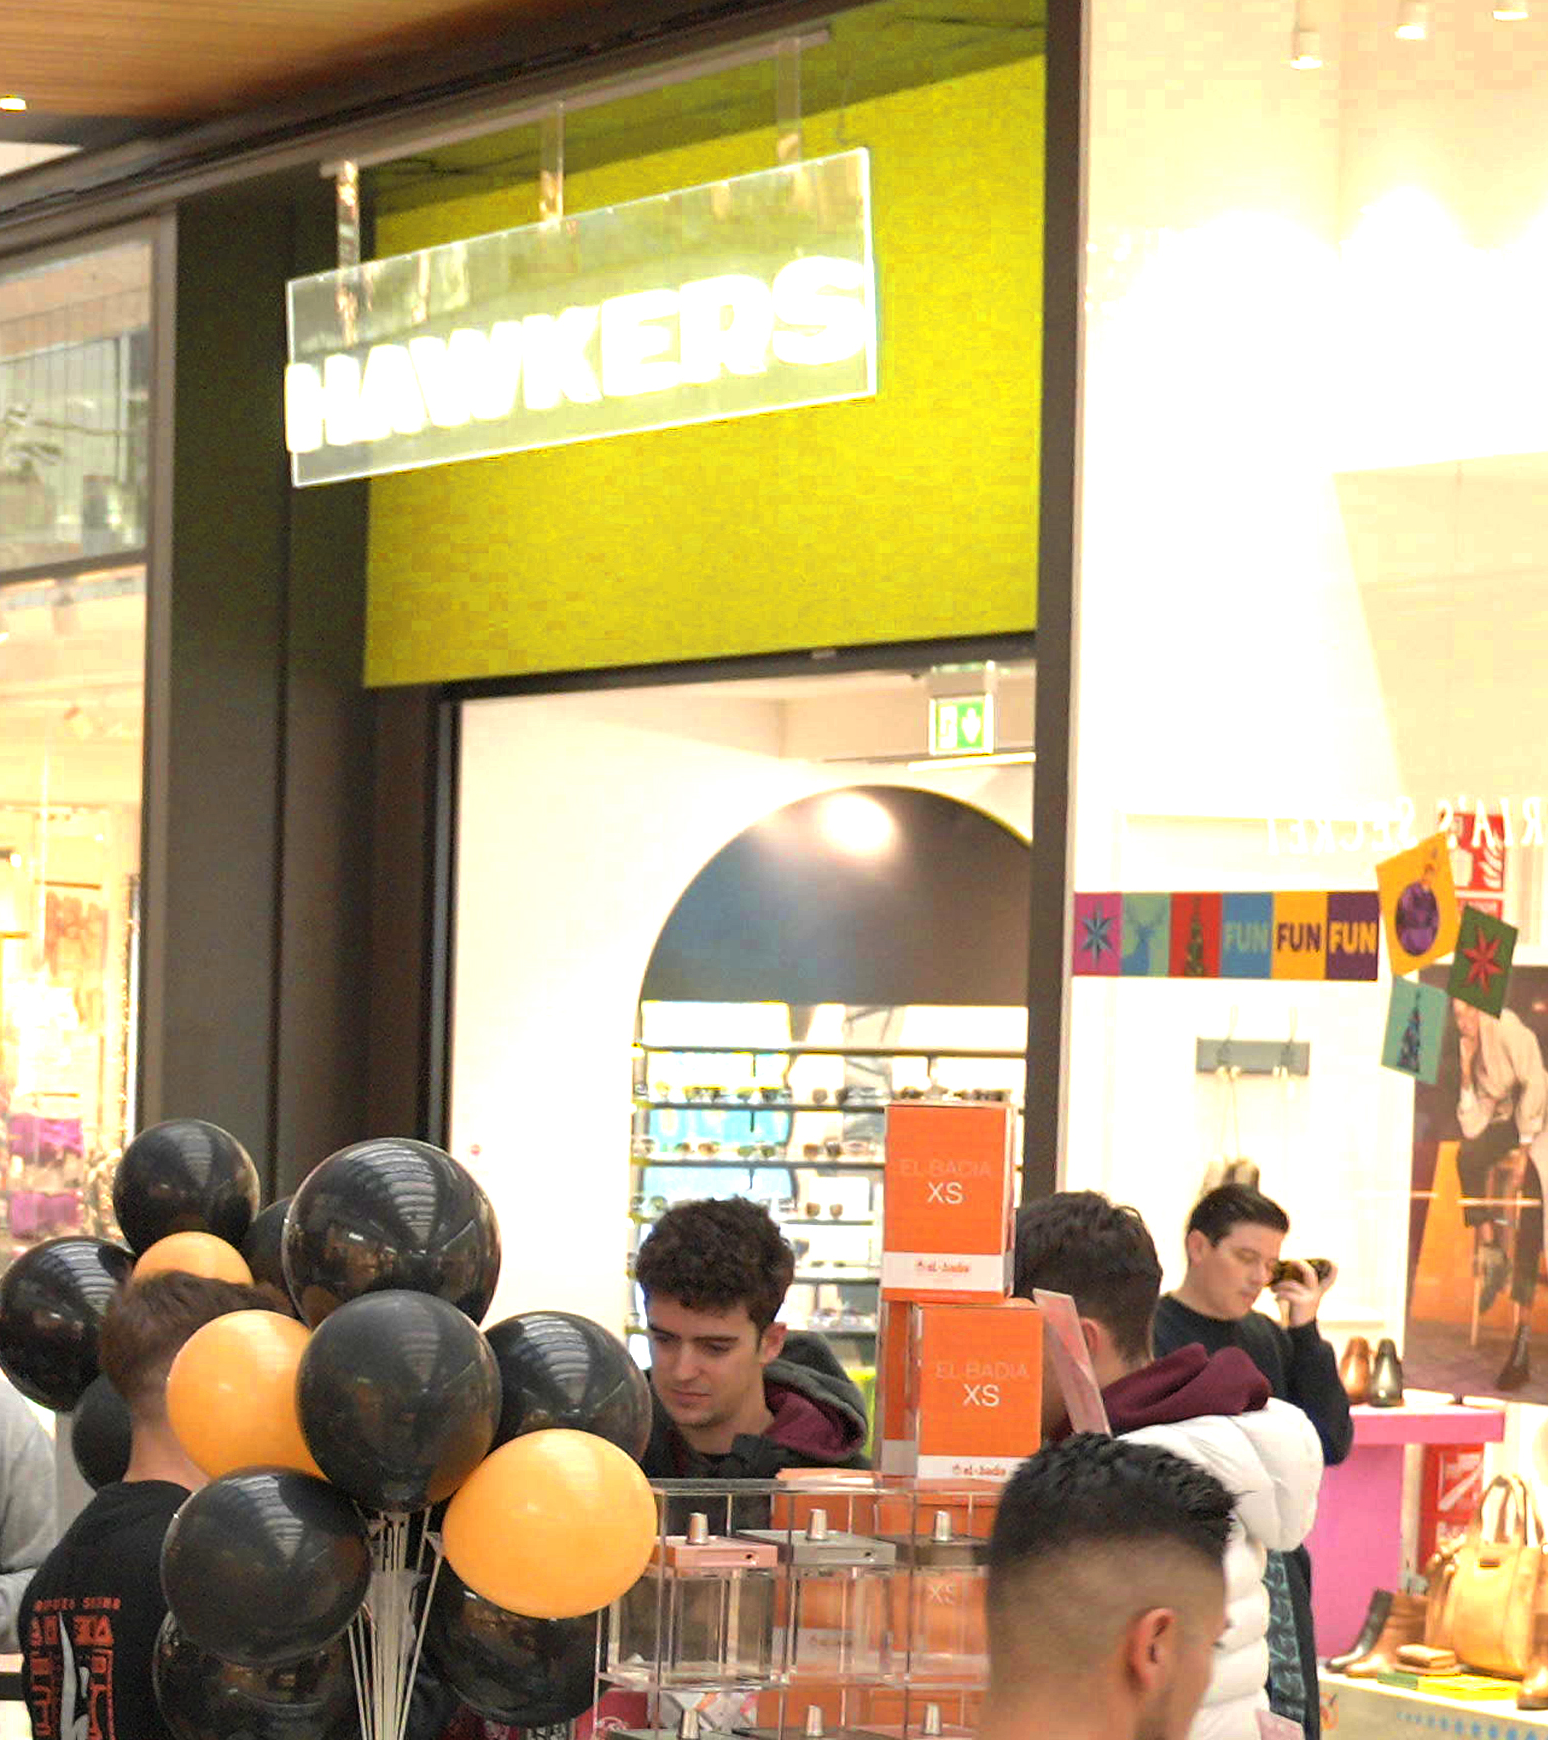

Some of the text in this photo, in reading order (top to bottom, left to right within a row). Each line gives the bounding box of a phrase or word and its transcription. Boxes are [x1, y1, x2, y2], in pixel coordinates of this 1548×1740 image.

[285, 255, 867, 453] HAWKERS
[1225, 920, 1377, 954] FUN FUN FUN
[927, 1181, 965, 1205] XS
[962, 1383, 1001, 1407] XS
